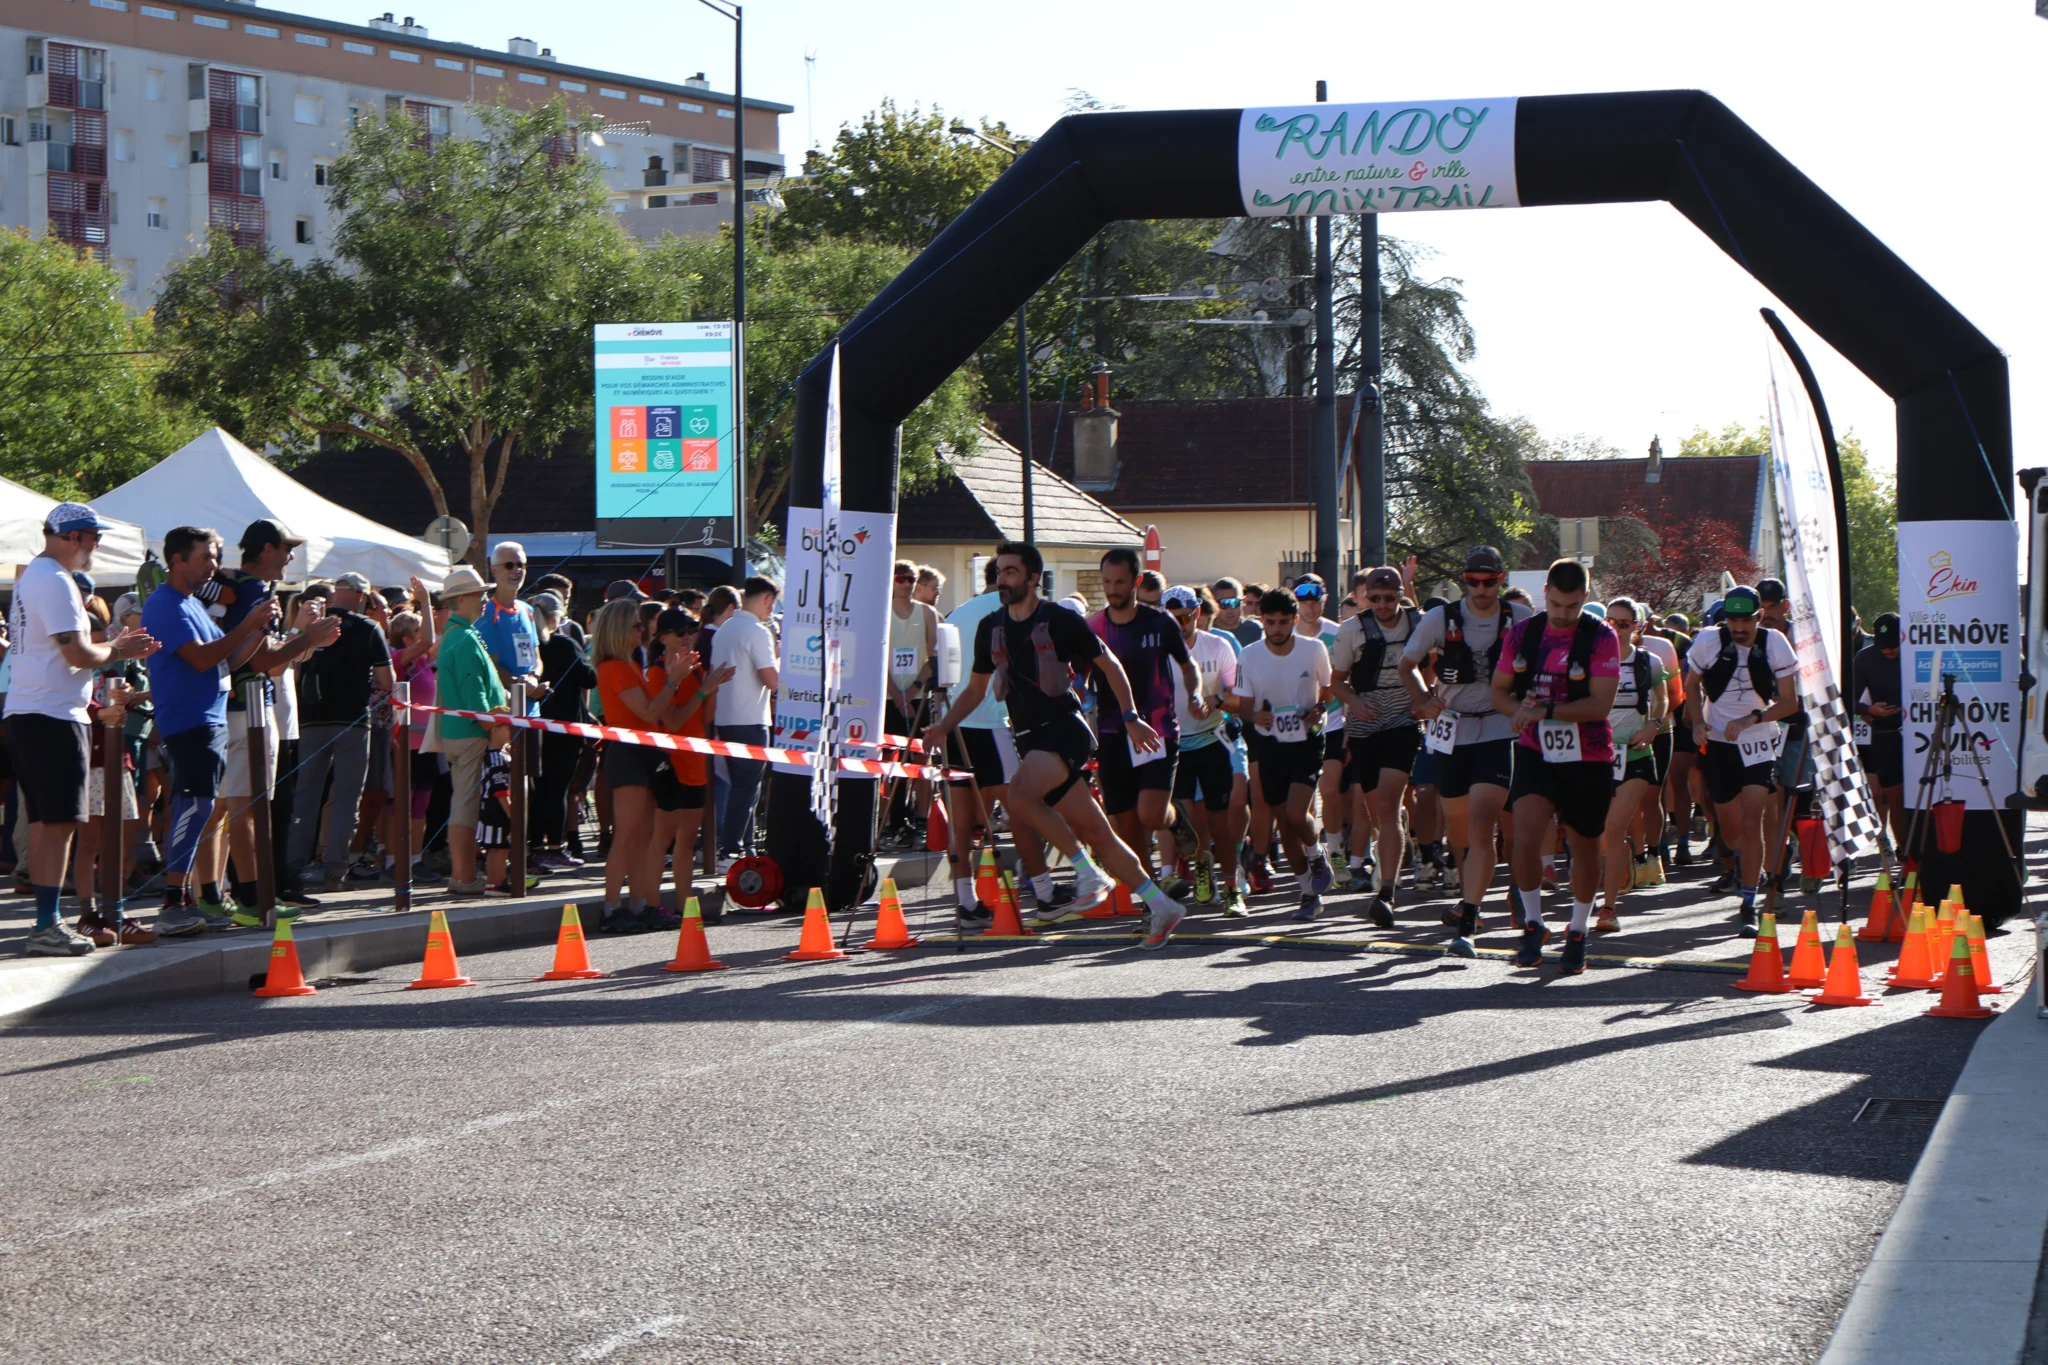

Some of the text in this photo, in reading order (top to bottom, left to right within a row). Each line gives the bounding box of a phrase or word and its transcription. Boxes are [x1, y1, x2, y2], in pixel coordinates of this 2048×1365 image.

[1275, 107, 1490, 160] RANDO
[1289, 159, 1470, 185] entre nature & ville
[802, 527, 856, 555] buo
[798, 569, 853, 612] JZ
[1926, 567, 1979, 598] Ekin
[1909, 611, 1946, 624] Ville de
[1908, 617, 2009, 645] CHENÔVE
[896, 654, 914, 667] 237
[1917, 660, 1999, 670] Acte & Sportive
[788, 688, 823, 703] Vertica
[1910, 696, 2010, 723] CHÔVE
[777, 715, 823, 734] SUPE
[1276, 714, 1300, 733] 069
[1430, 719, 1453, 742] 063
[1855, 724, 1868, 737] 56
[1543, 729, 1575, 751] 052
[1612, 754, 1622, 771] 4
[1931, 754, 1991, 766] bilités
